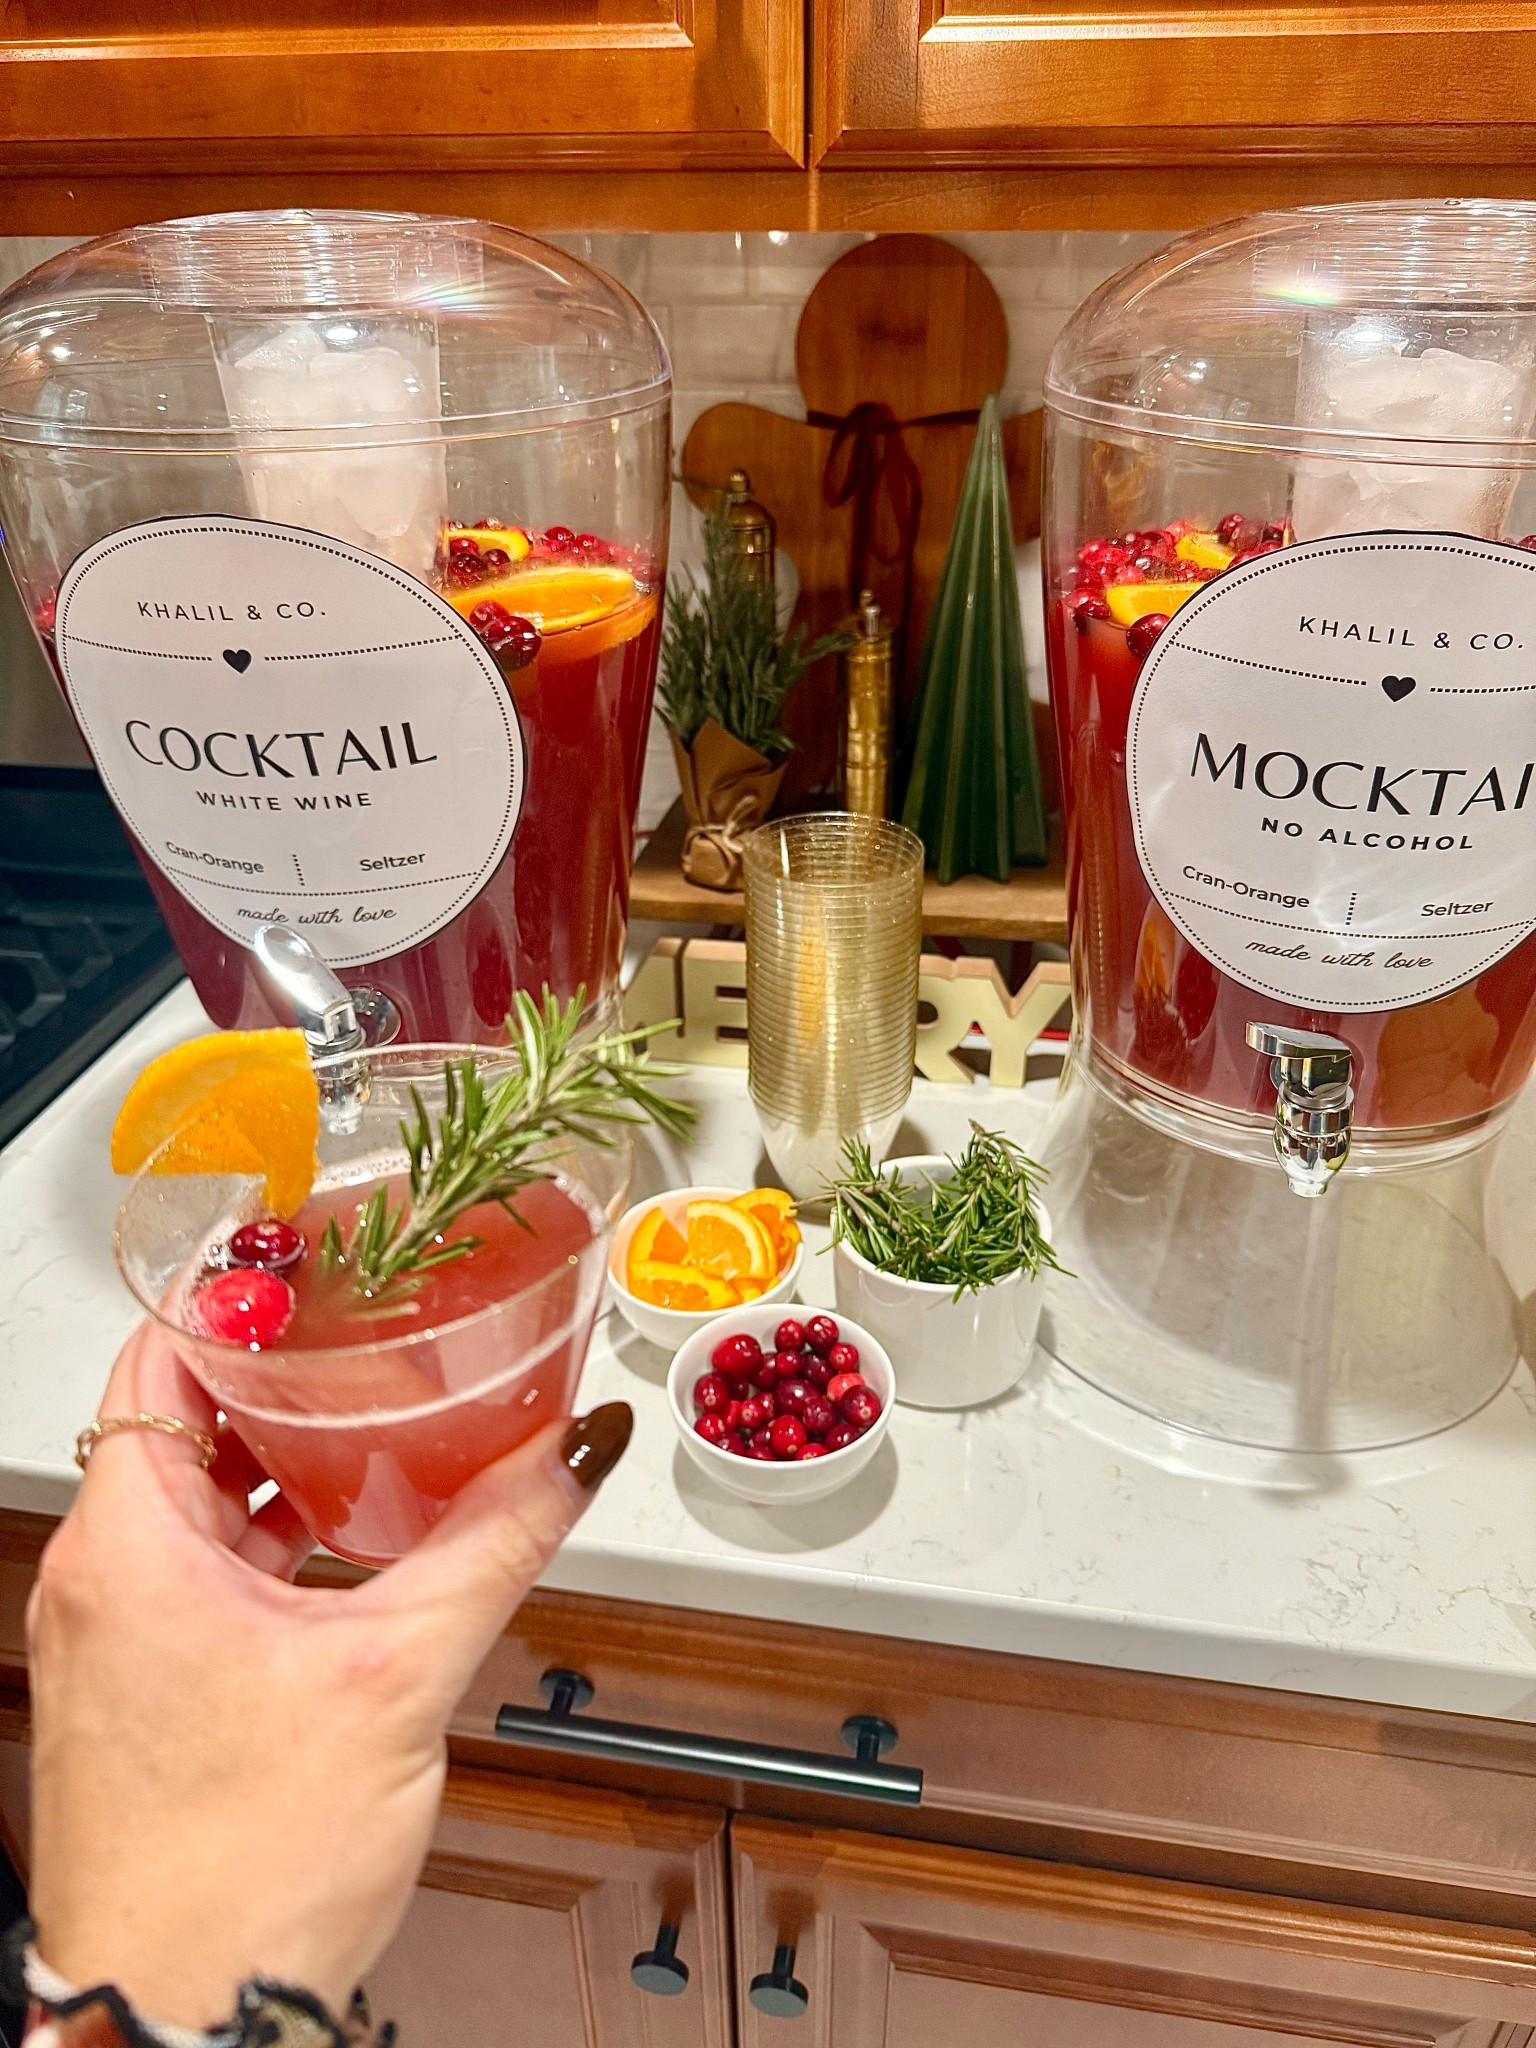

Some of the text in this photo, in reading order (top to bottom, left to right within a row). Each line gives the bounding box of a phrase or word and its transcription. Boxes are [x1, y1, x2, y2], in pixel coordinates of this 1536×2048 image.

[137, 601, 326, 622] KHALIL & CO.
[1299, 616, 1524, 651] KHALIL & CO.
[125, 720, 438, 779] COCKTAIL
[1190, 733, 1536, 817] MOCKTAI
[195, 791, 373, 811] WHITE WINE
[1261, 817, 1474, 851] NO ALCOHOL
[165, 841, 265, 875] Cran-Orange
[359, 853, 426, 872] Seltzer
[1182, 865, 1310, 909] Cran-Orange
[236, 906, 398, 925] made with love
[1420, 900, 1494, 918] Seltzer
[1245, 940, 1434, 969] made with love
